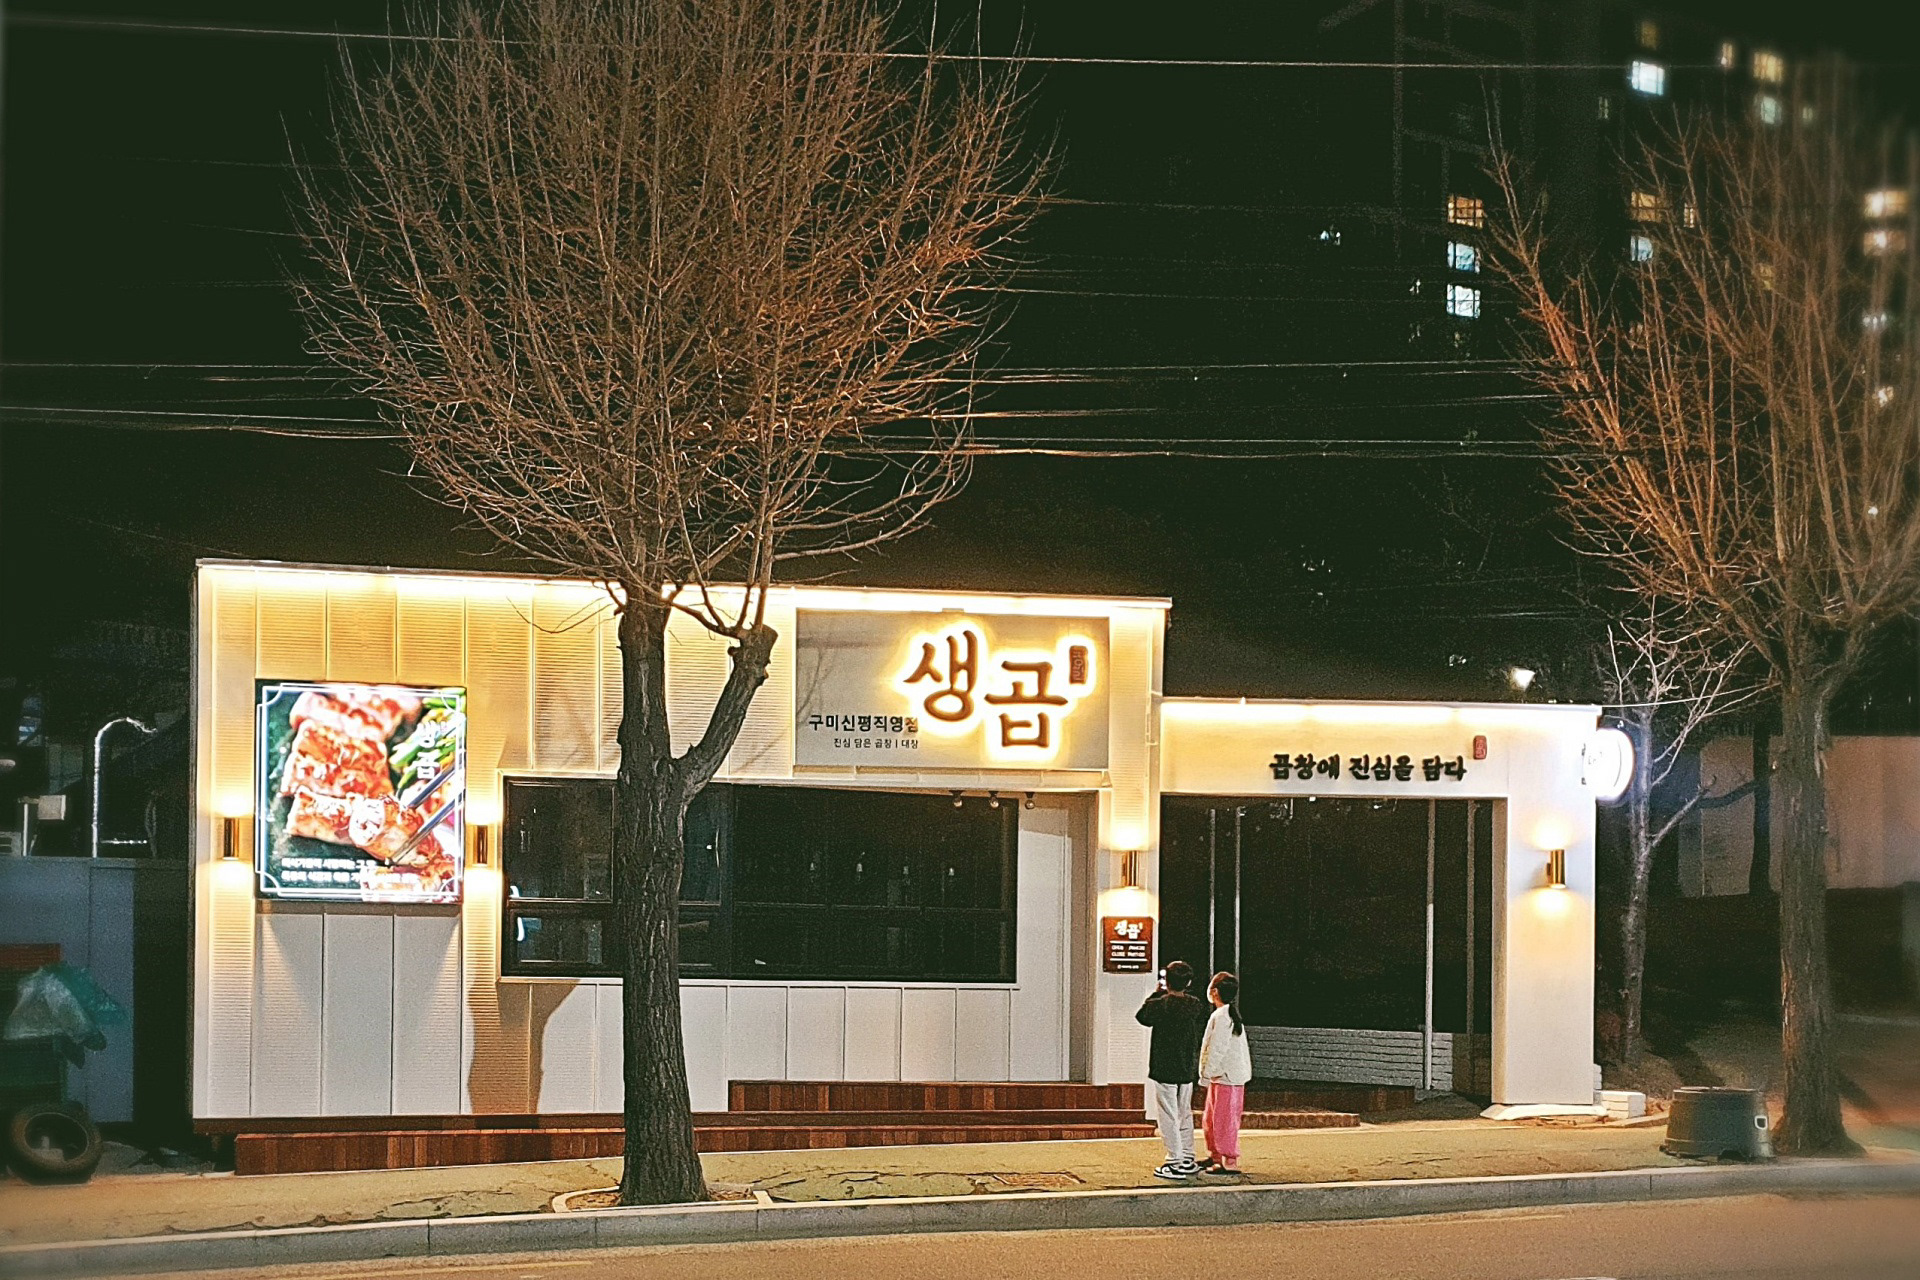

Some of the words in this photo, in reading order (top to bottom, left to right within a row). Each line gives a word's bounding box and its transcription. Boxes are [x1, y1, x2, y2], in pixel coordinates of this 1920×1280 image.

[903, 630, 1068, 748] 생곱
[809, 715, 918, 732] 구미신평직영점
[834, 738, 851, 748] 진심
[854, 738, 871, 748] 담은
[875, 739, 892, 748] 곱창
[901, 739, 918, 749] 대창
[1269, 753, 1340, 781] 곱창에
[1349, 754, 1414, 781] 진심을
[1421, 755, 1467, 781] 담다
